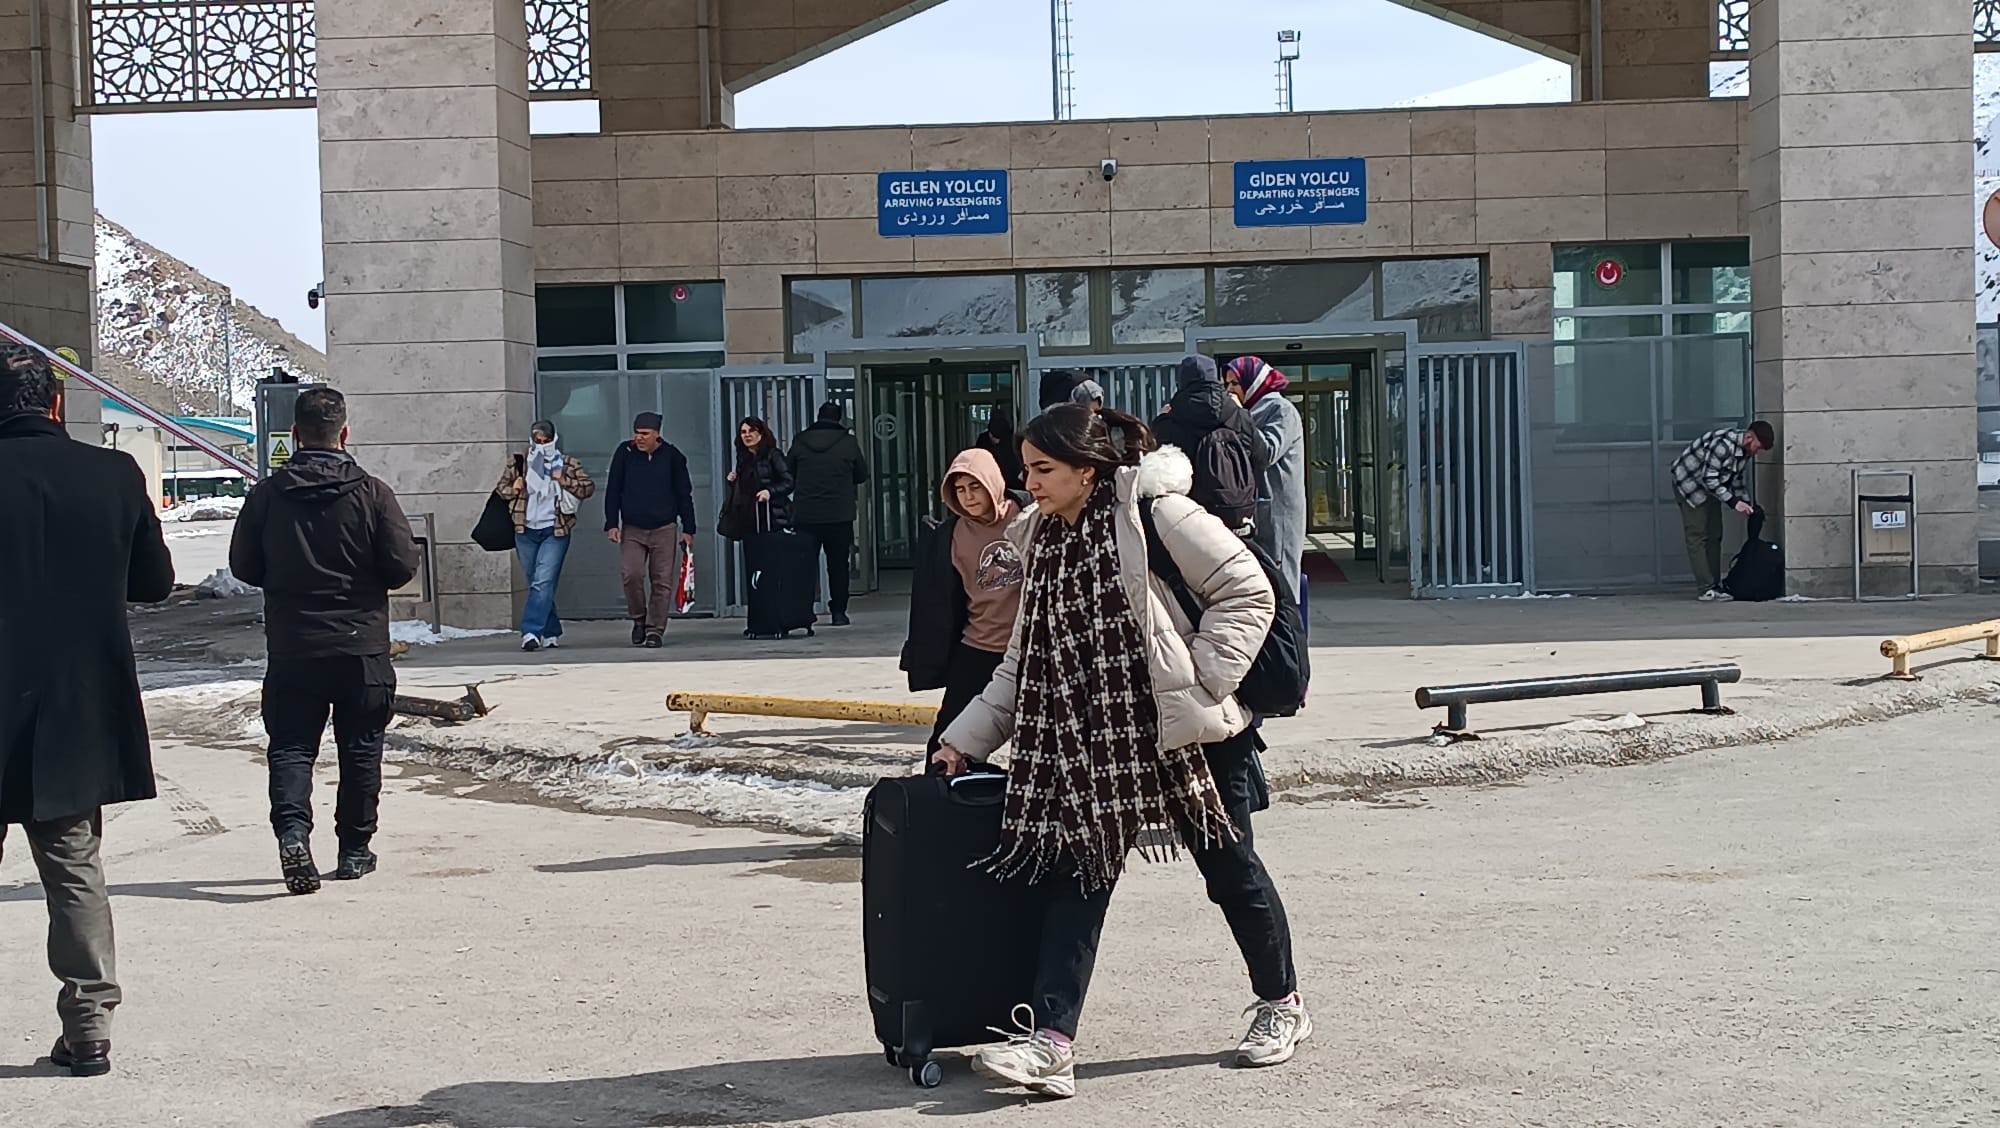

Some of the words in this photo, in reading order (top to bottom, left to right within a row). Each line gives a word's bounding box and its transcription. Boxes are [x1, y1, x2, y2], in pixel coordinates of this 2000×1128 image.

[1249, 171, 1296, 187] GİDEN
[1300, 171, 1350, 186] YOLCU
[890, 180, 940, 195] GELEN
[944, 179, 996, 193] YOLCU
[1239, 189, 1295, 199] DEPARTING
[1297, 187, 1360, 198] PASSENGERS
[884, 197, 934, 208] ARRIVING
[936, 196, 1002, 207] PASSENGERS
